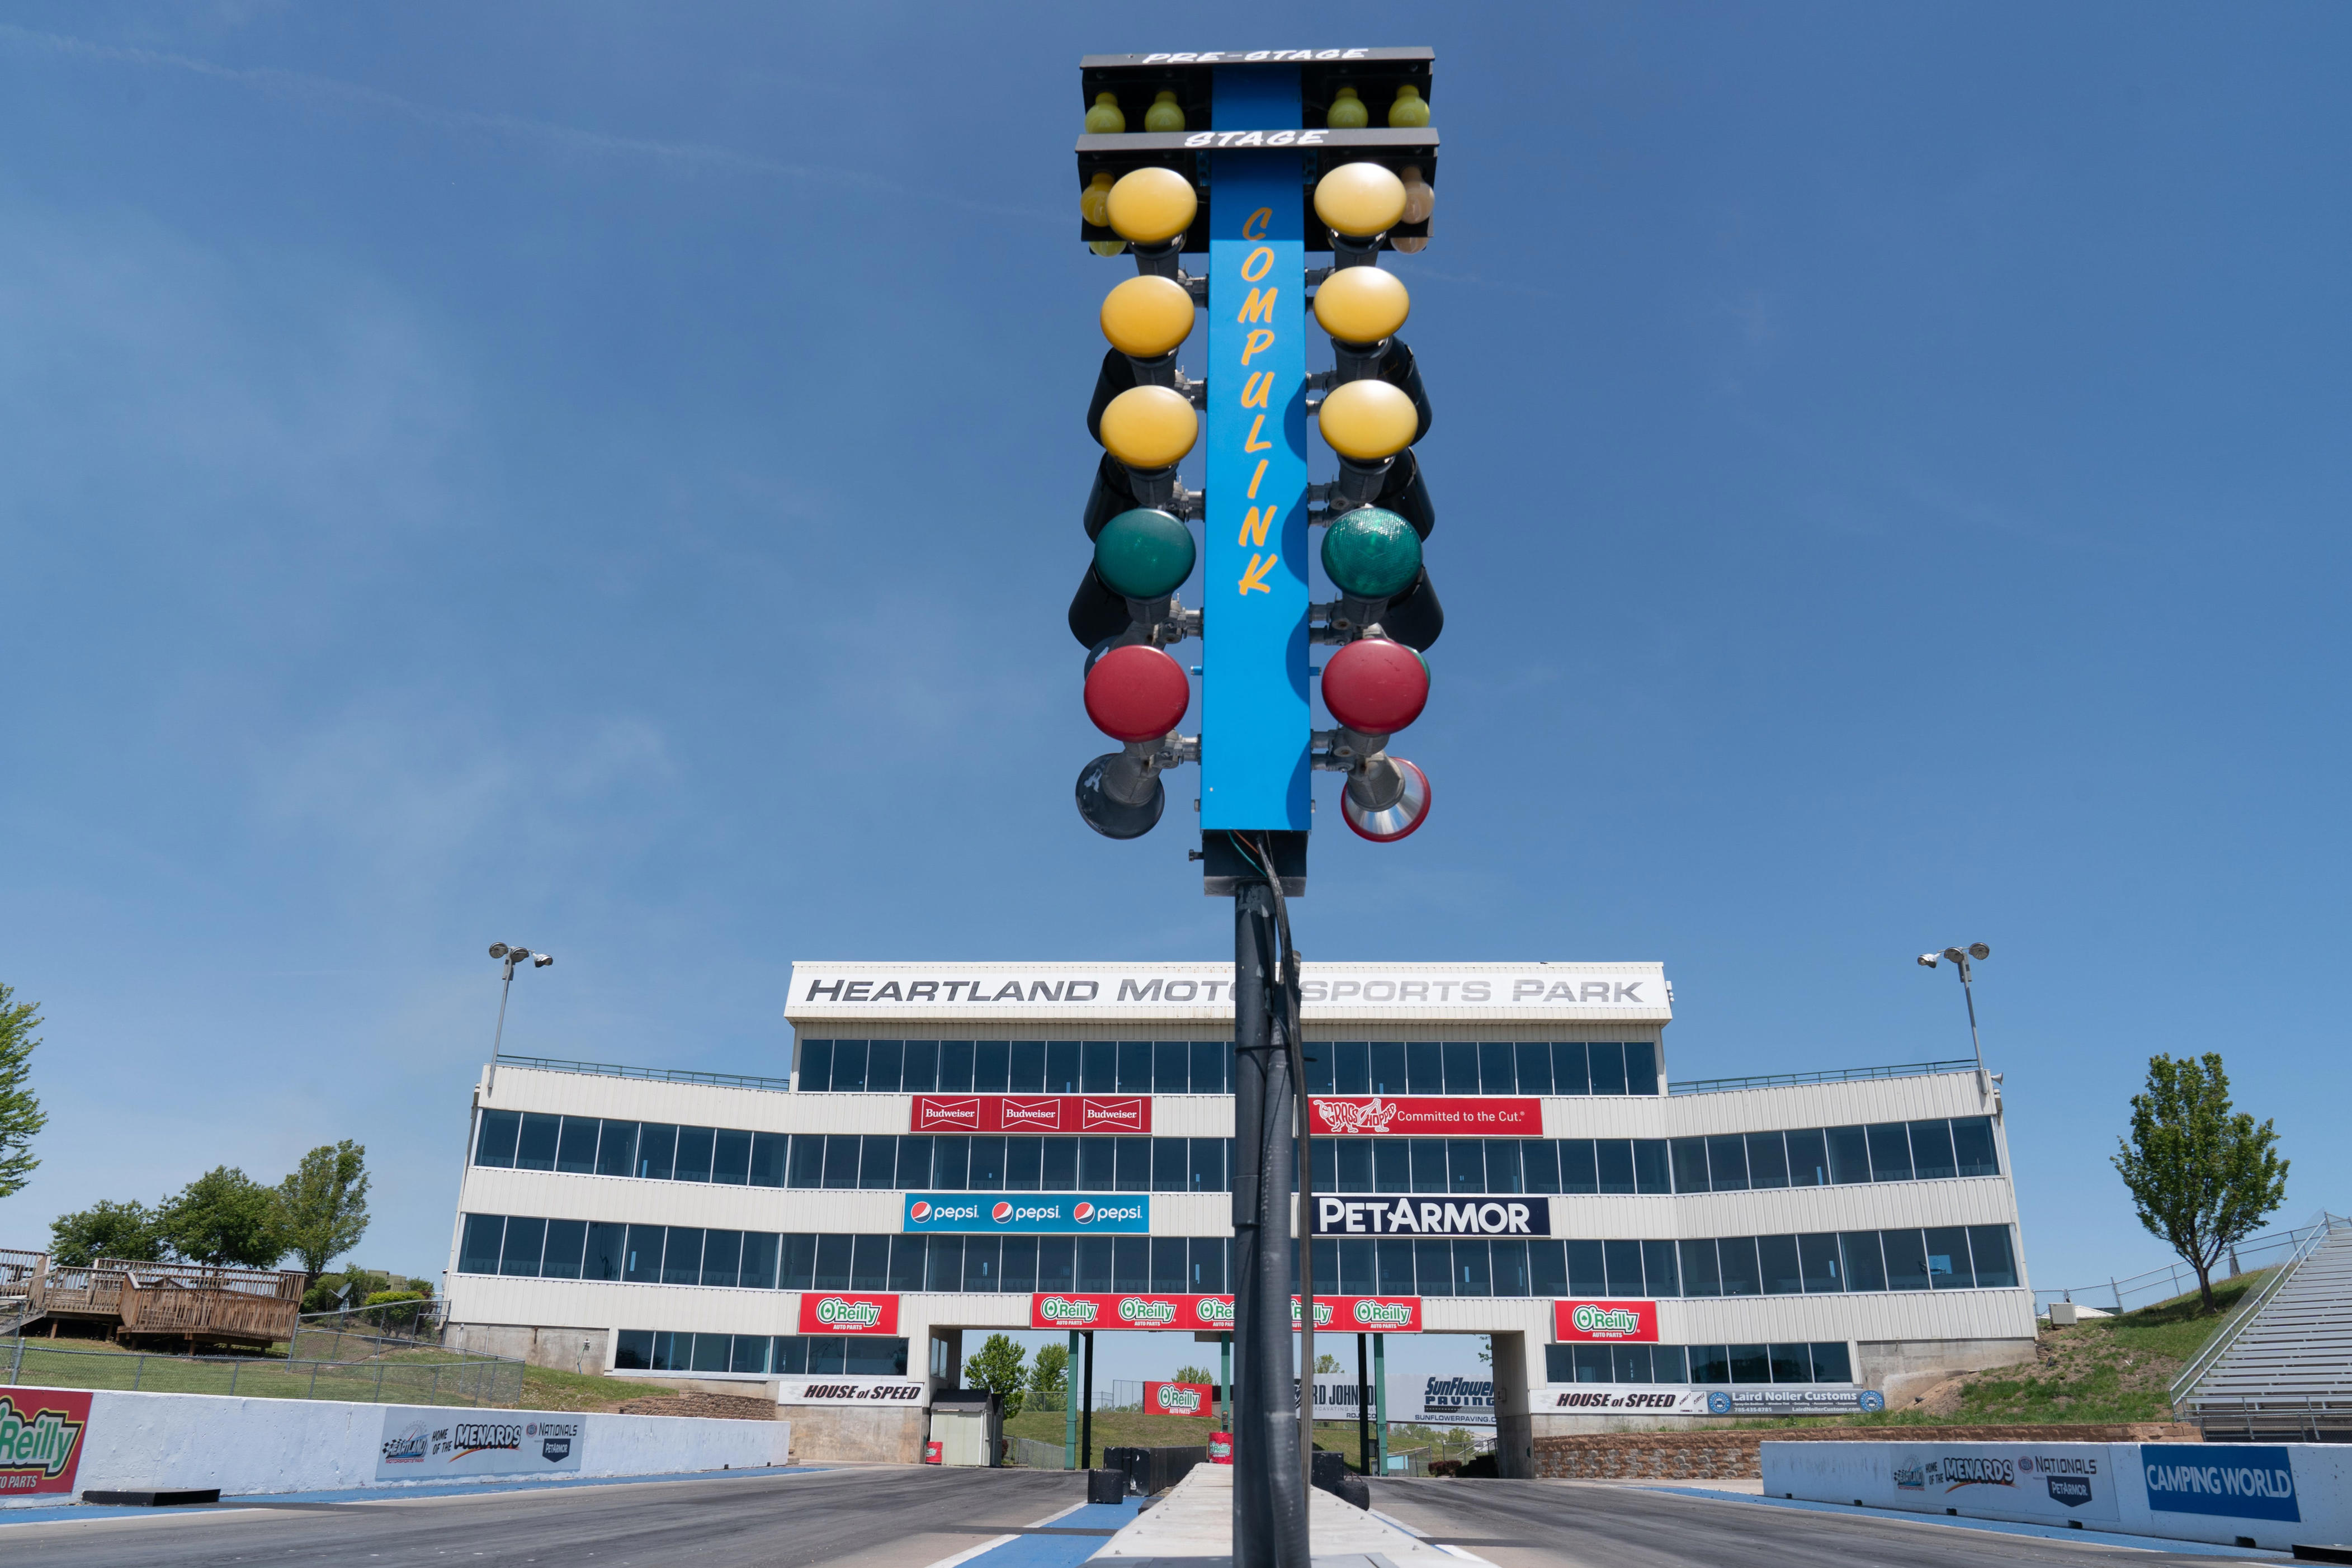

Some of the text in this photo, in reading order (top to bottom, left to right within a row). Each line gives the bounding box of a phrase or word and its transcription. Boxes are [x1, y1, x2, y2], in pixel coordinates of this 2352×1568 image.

[1142, 48, 1369, 64] PRE-STAGE
[1184, 130, 1329, 148] STAGE
[1238, 207, 1277, 596] COMPULINK
[806, 979, 1645, 1003] HEARTLAND MOTSPORTS PARK
[925, 1108, 975, 1118] Budweiser
[1006, 1109, 1055, 1118] Budweiser
[1087, 1109, 1137, 1119] Budweiser
[1397, 1111, 1460, 1121] Committed
[1463, 1112, 1474, 1121] to
[1477, 1111, 1495, 1121] the
[934, 1204, 978, 1221] pepsi
[1016, 1205, 1059, 1221] pepsi
[1097, 1205, 1141, 1222] pepsi
[819, 1300, 877, 1324] O'Reilly
[1042, 1299, 1097, 1320] O'Reilly
[1121, 1300, 1175, 1321] O'Reilly
[1356, 1302, 1409, 1322] O'Reilly
[1575, 1307, 1635, 1331] O'Reilly
[803, 1385, 921, 1400] HOUSE of SPEED
[1159, 1387, 1198, 1409] O'Reilly
[1329, 1385, 1377, 1405] JOHNO
[1556, 1393, 1612, 1406] HOUSE
[1610, 1397, 1624, 1407] of
[1625, 1394, 1676, 1408] SPEED
[1732, 1391, 1857, 1401] Laird Noller Customs
[1415, 1414, 1497, 1423] SUNFLOWERPAVING.C
[0, 1406, 73, 1468] 'Reilly
[432, 1428, 448, 1442] HOME
[454, 1424, 522, 1449] MENARDS
[539, 1422, 578, 1437] NATIONALS
[432, 1441, 452, 1455] OF THE
[1944, 1457, 2014, 1484] MENARDS
[2035, 1455, 2097, 1475] NATIONALS
[8, 1475, 38, 1488] PARTS
[2146, 1464, 2292, 1499] CAMPING WORLD
